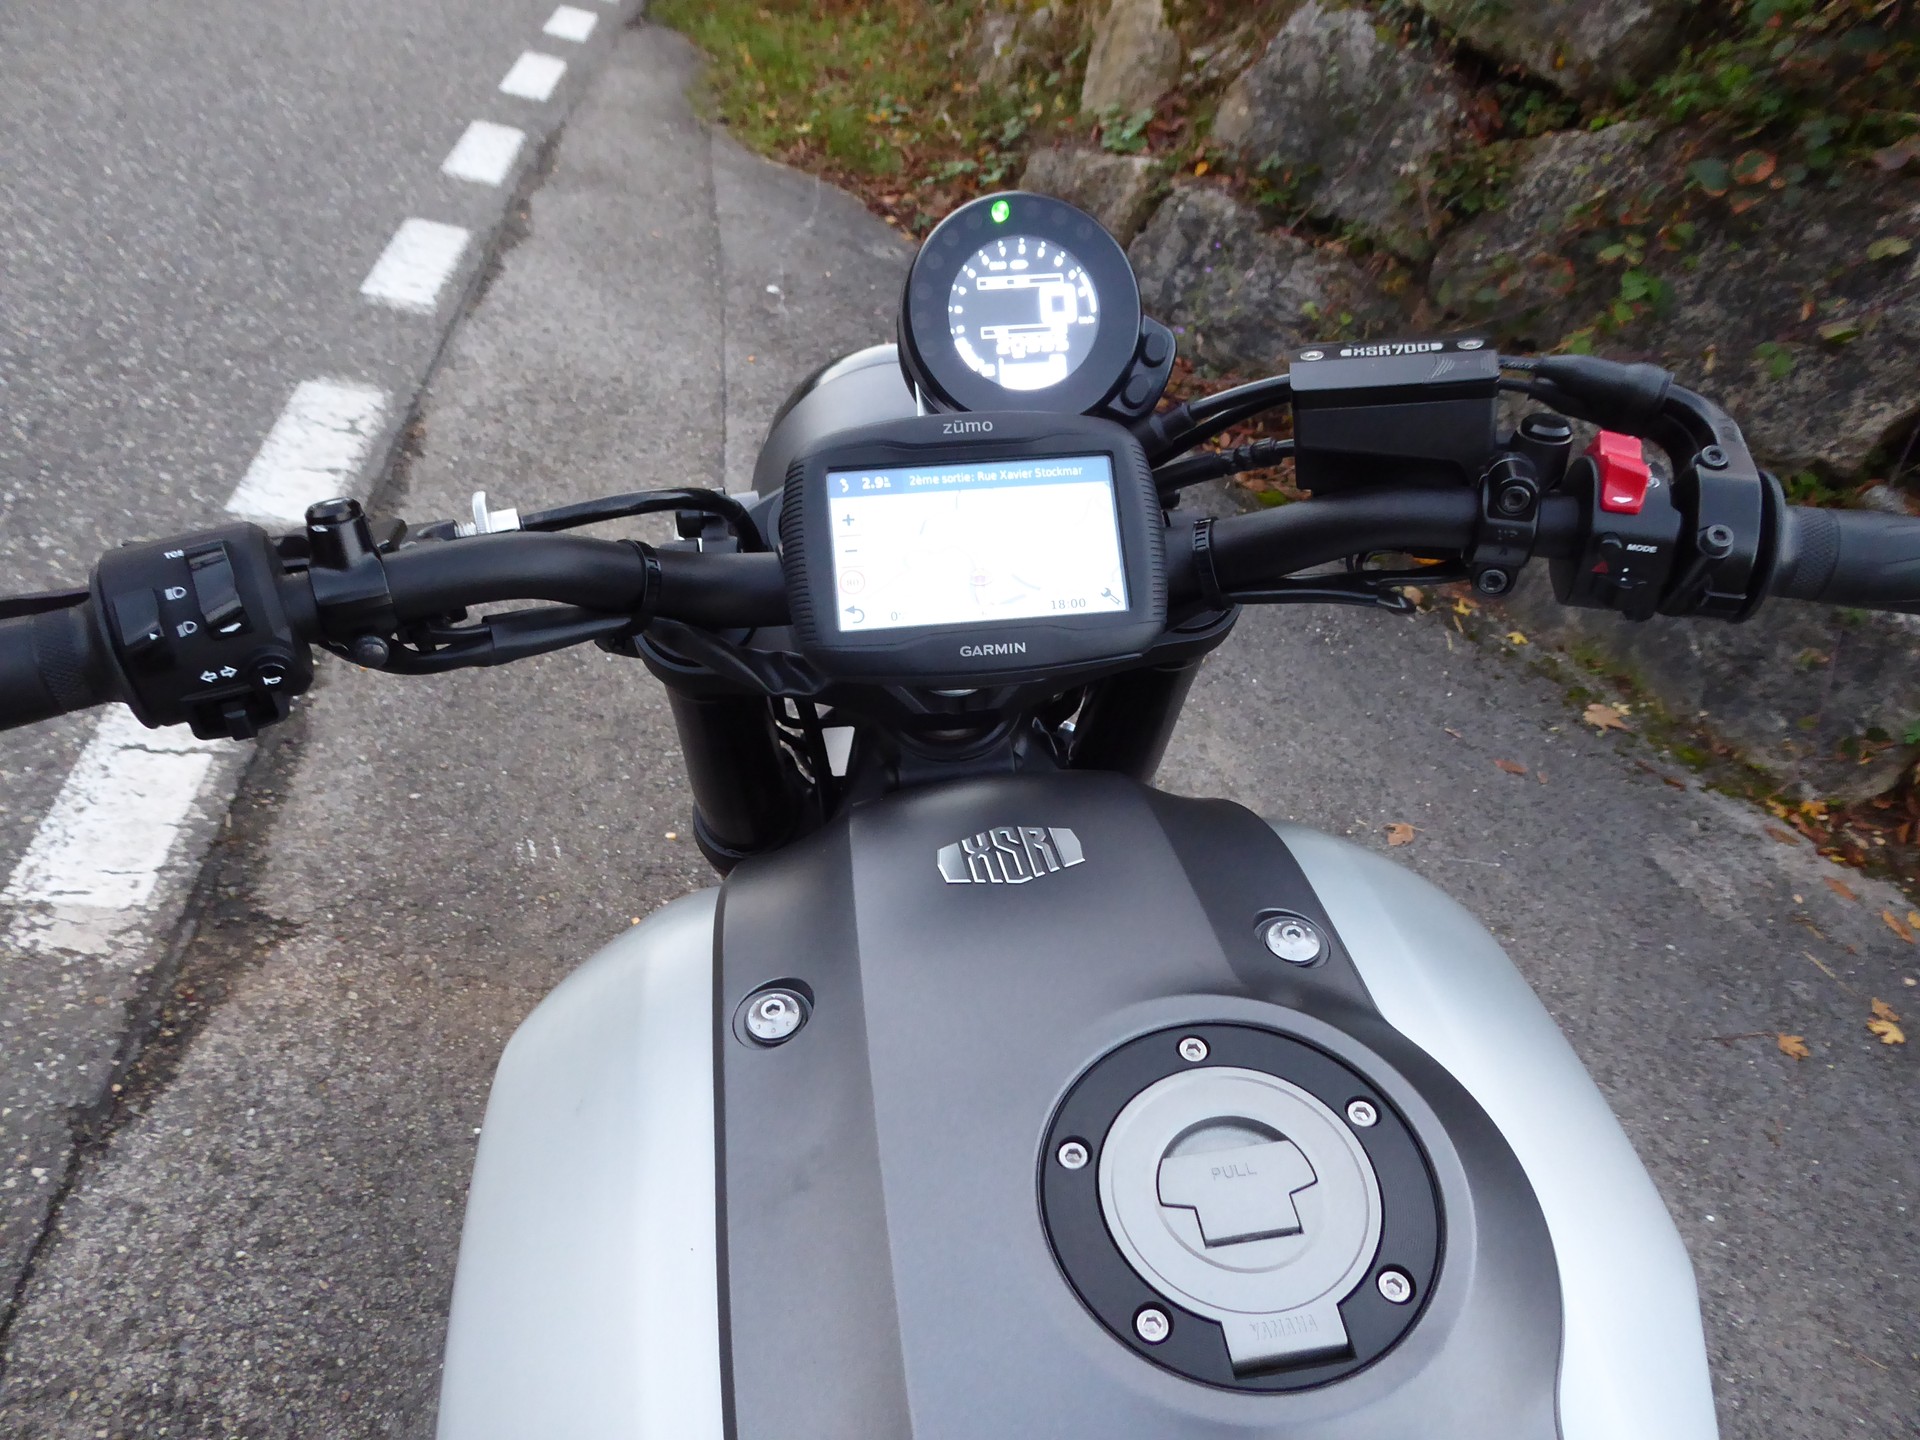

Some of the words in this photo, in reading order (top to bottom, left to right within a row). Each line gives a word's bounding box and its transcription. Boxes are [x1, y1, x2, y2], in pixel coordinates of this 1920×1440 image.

[1353, 342, 1430, 358] XSR700
[909, 474, 940, 487] 2ème
[942, 471, 976, 484] sortie:
[977, 470, 998, 482] Rue
[1000, 469, 1033, 481] Xavier
[1035, 466, 1083, 478] Stockmar
[1626, 543, 1658, 555] MODE
[1051, 598, 1086, 610] 18:00
[960, 642, 1026, 658] GARMIN
[961, 826, 1060, 885] XSR
[1211, 1162, 1258, 1180] PULL
[1249, 1314, 1319, 1340] YAMAHA
